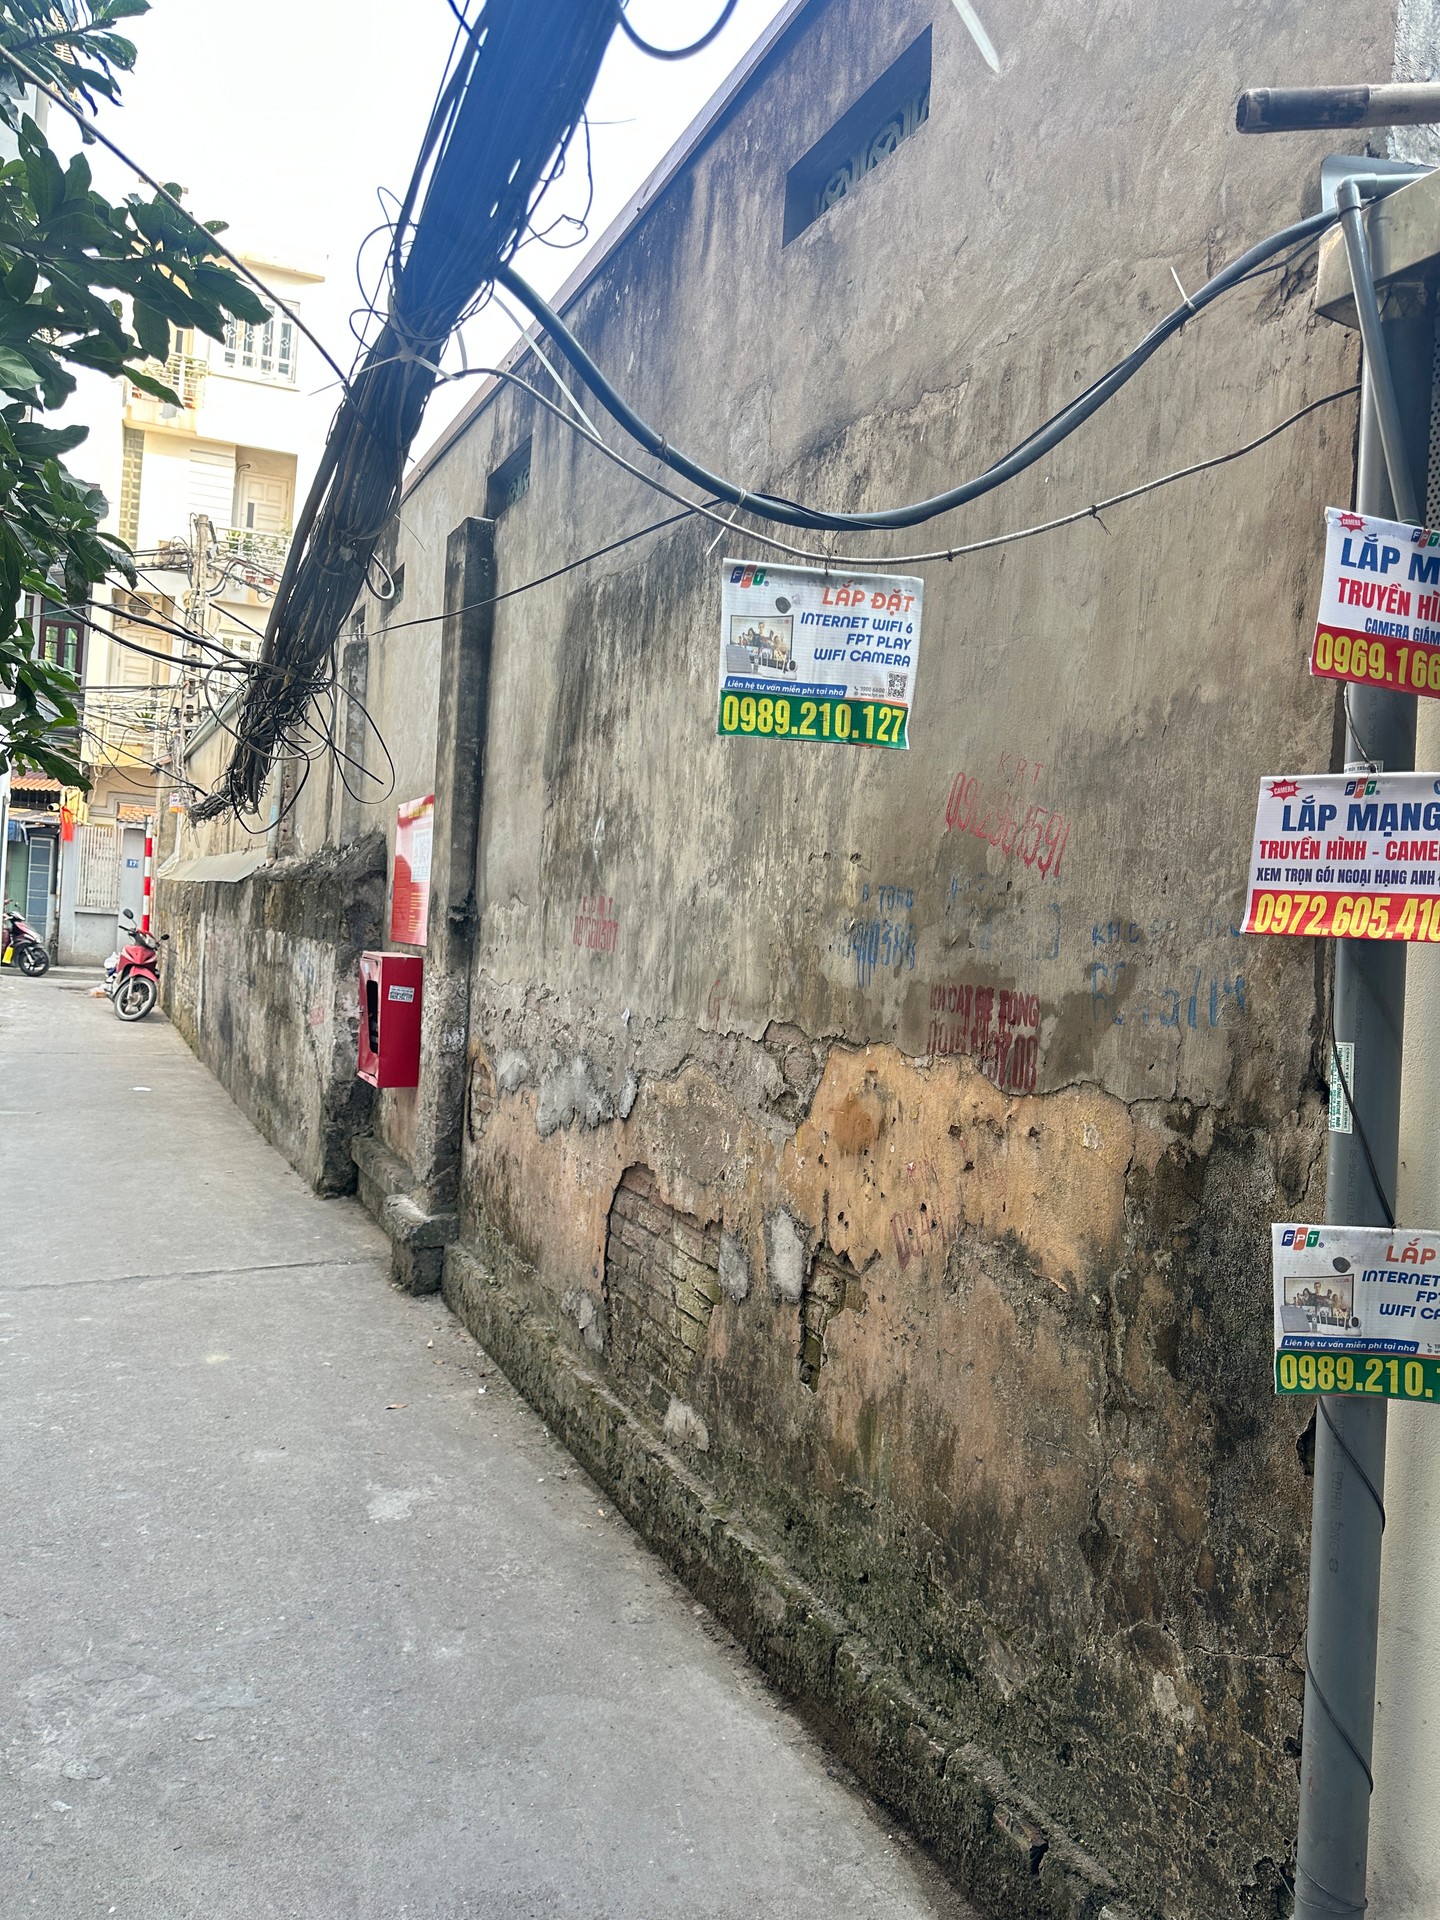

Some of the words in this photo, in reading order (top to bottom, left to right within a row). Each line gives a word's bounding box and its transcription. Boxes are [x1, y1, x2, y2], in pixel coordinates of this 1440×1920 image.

[1342, 518, 1361, 526] CAMERA
[1410, 528, 1440, 548] FPT
[1340, 533, 1400, 574] LẮP
[730, 564, 767, 588] FPT
[822, 580, 866, 608] LẮP
[871, 589, 914, 616] ĐẶT
[1338, 577, 1411, 616] TRUYỀN
[1417, 590, 1440, 623] HÌ
[800, 612, 869, 630] INTERNET
[872, 618, 904, 634] WIFI
[906, 622, 913, 634] 6
[1365, 618, 1409, 640] CAMERA
[846, 634, 874, 646] FPT
[876, 636, 912, 650] PLAY
[814, 648, 846, 661] WIFI
[850, 650, 911, 667] CAMERA
[728, 680, 744, 688] Liên
[745, 682, 755, 690] hệ
[766, 683, 780, 692] vấn
[782, 684, 800, 694] miễn
[802, 687, 814, 695] phí
[816, 688, 828, 696] tại
[723, 695, 905, 742] 0989.210.127
[1273, 784, 1295, 795] CAMERA
[1344, 778, 1377, 798] FPT
[1282, 795, 1338, 832] LẮP
[1346, 802, 1440, 837] MẠNG
[1260, 836, 1320, 860] TRUYỀN
[1326, 836, 1367, 860] HÌNH
[1386, 841, 1440, 861] CAME
[1256, 868, 1282, 882] XEM
[1285, 868, 1312, 886] TRỌN
[1316, 866, 1334, 883] GÓI
[1338, 869, 1372, 887] NGOẠI
[1374, 870, 1407, 888] HẠNG
[1410, 870, 1436, 885] ANH
[1282, 1227, 1320, 1250] FPT
[1386, 1238, 1436, 1265] LẮP
[1362, 1270, 1440, 1287] INTERNET
[1416, 1291, 1440, 1303] FP
[1380, 1304, 1416, 1318] WIFI
[1368, 1342, 1382, 1350] phí
[1398, 1344, 1415, 1352] nhà
[1280, 1354, 1440, 1398] 0989.210.
